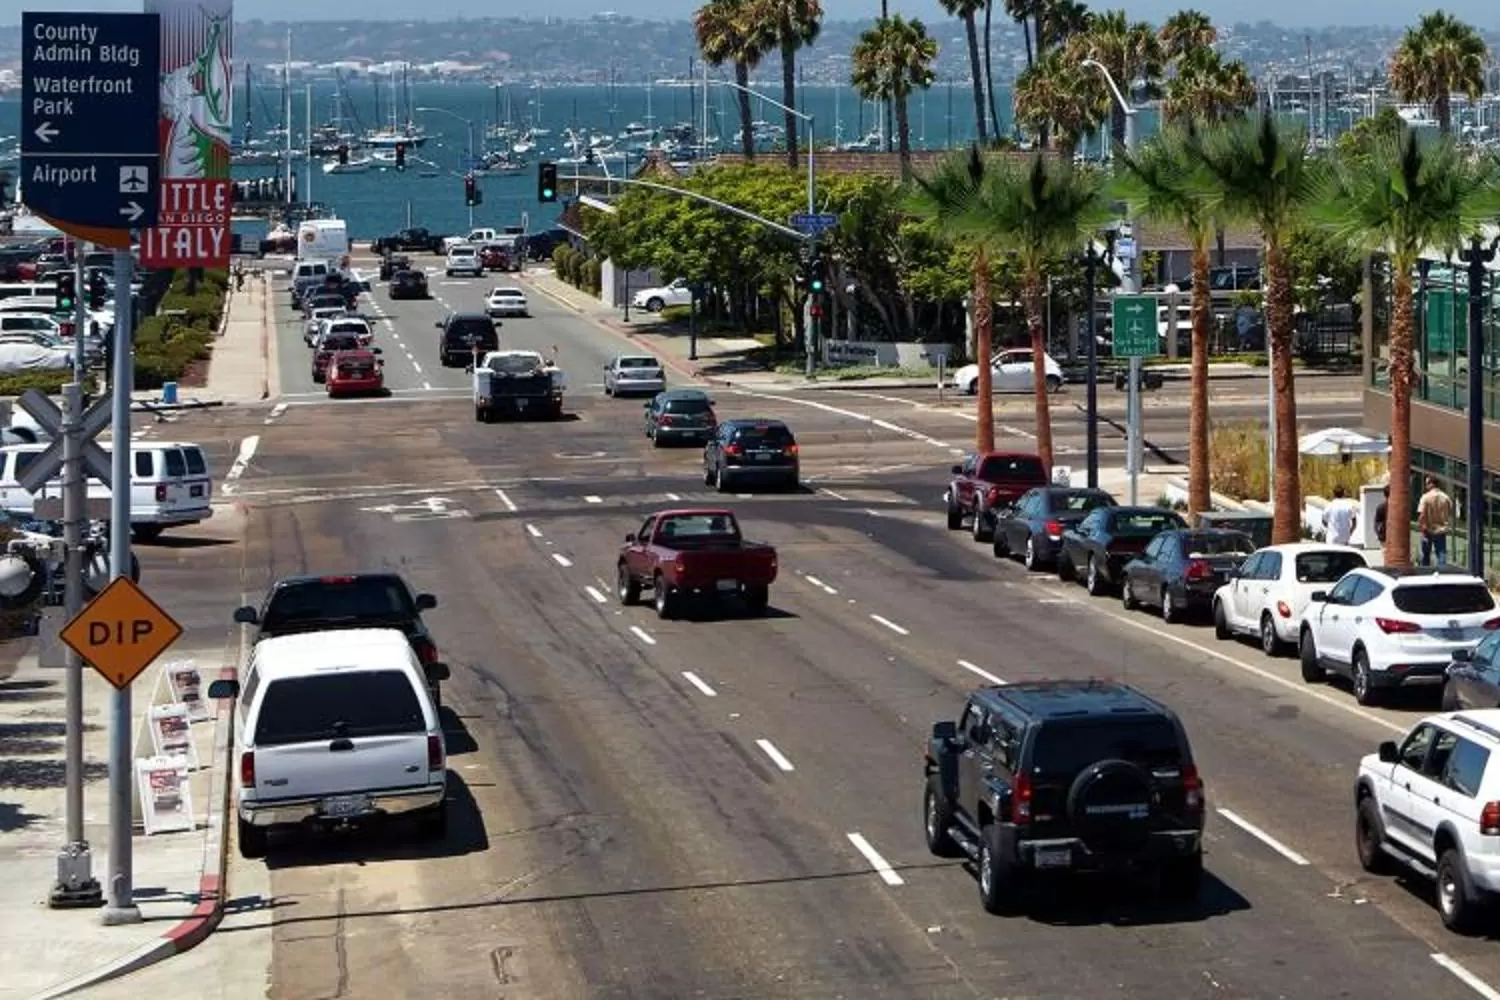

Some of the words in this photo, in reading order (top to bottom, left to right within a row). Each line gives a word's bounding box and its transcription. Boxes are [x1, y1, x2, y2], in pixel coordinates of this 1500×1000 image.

[33, 22, 98, 45] County
[33, 43, 92, 62] Admin
[99, 44, 140, 67] Bldg
[33, 75, 134, 94] Waterfront
[33, 97, 74, 115] Park
[32, 164, 98, 187] Airport
[160, 183, 226, 211] ITTLE
[181, 213, 226, 223] DIEGO
[146, 227, 225, 260] ITALY
[89, 619, 153, 647] DIP
